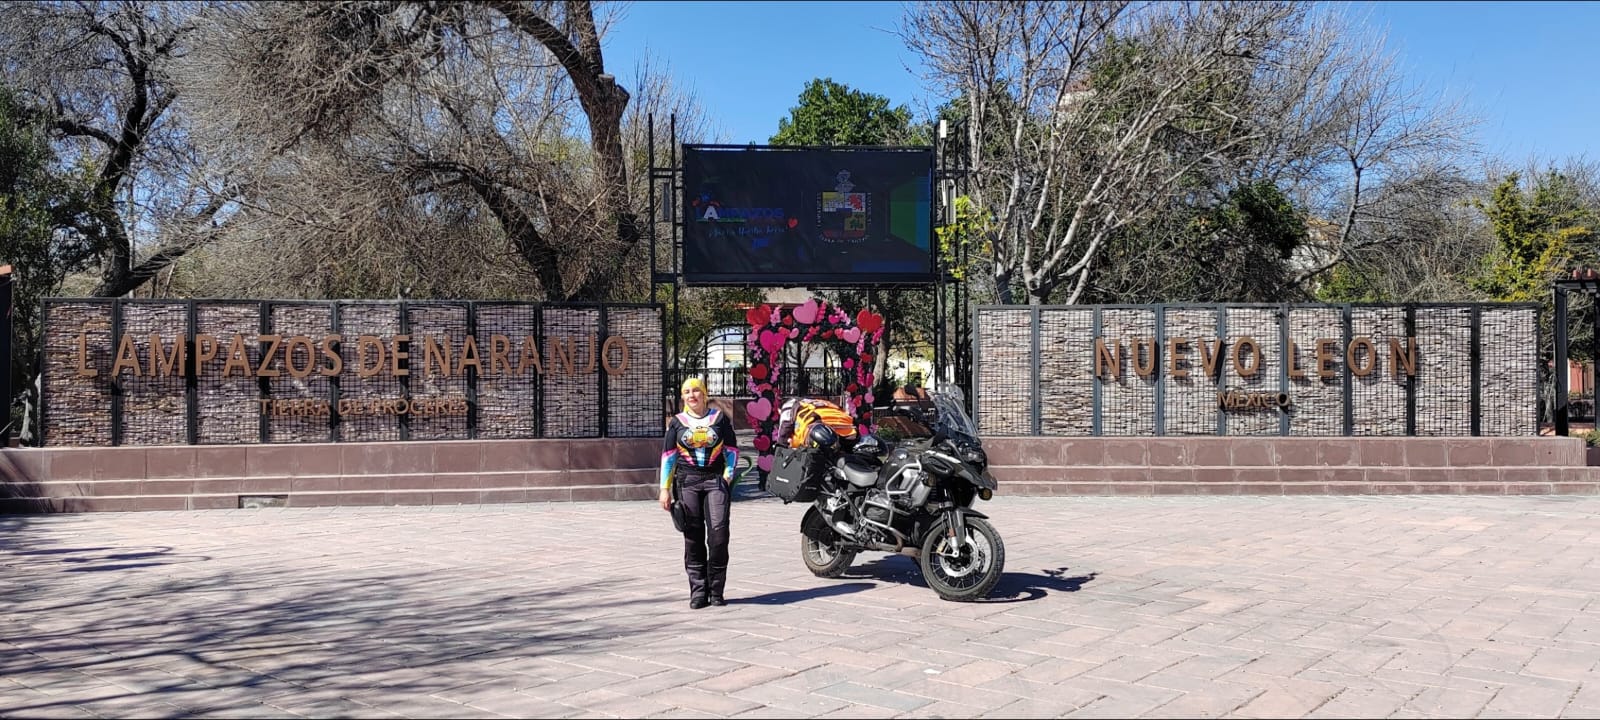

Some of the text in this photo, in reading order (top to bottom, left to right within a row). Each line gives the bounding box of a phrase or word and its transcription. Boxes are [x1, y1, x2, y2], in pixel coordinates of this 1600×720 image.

[78, 333, 629, 377] LAMPAZOS DE NARANJO
[1095, 337, 1416, 377] NUEVO LEON
[260, 398, 331, 416] TIERRA
[338, 398, 363, 415] DE
